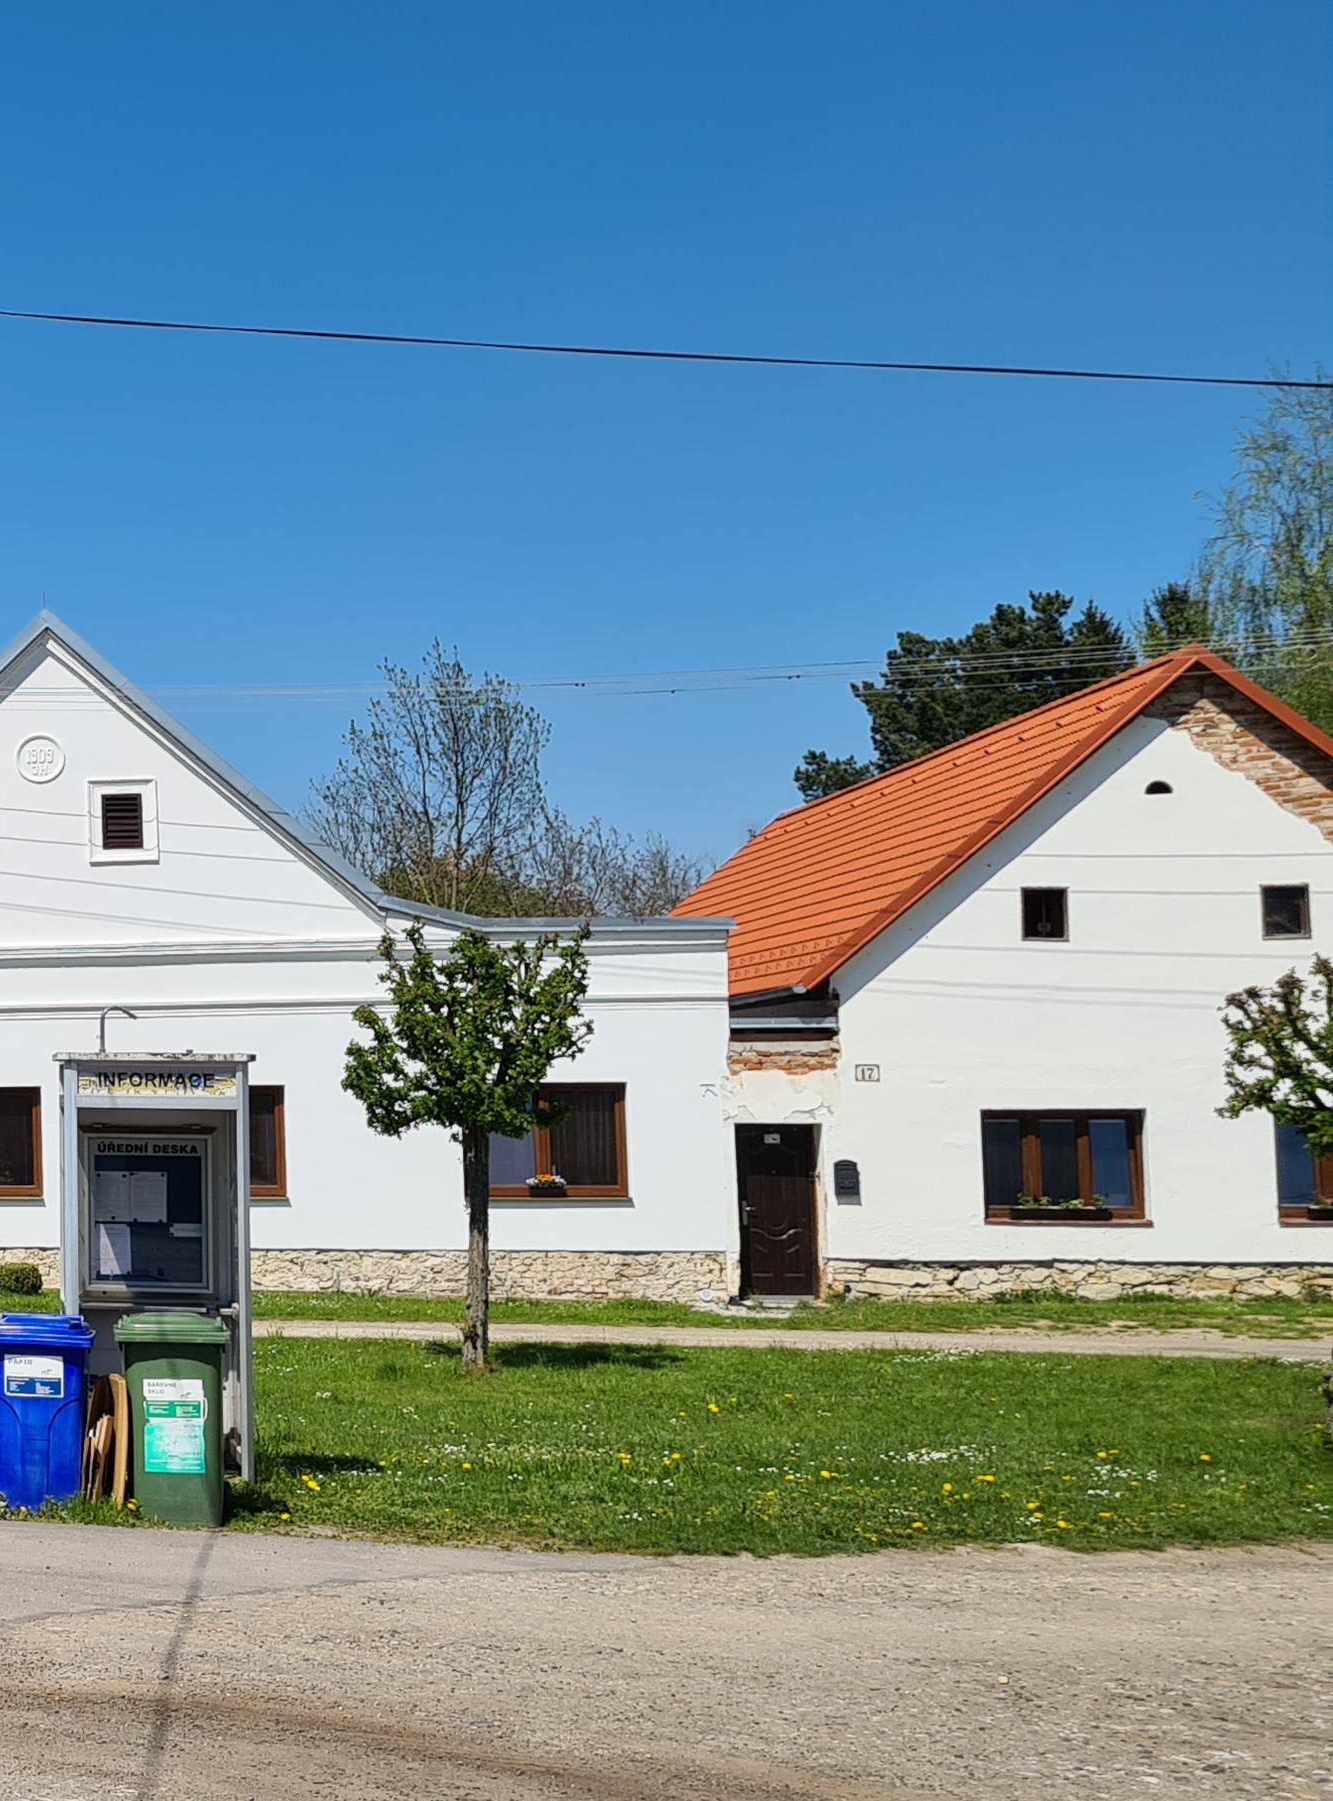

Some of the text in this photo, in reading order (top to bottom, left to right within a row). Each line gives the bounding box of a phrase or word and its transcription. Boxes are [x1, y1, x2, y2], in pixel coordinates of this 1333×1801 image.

[97, 1072, 215, 1088] INFORMACE
[97, 1141, 199, 1155] ÚŘEDNÍ DESKA
